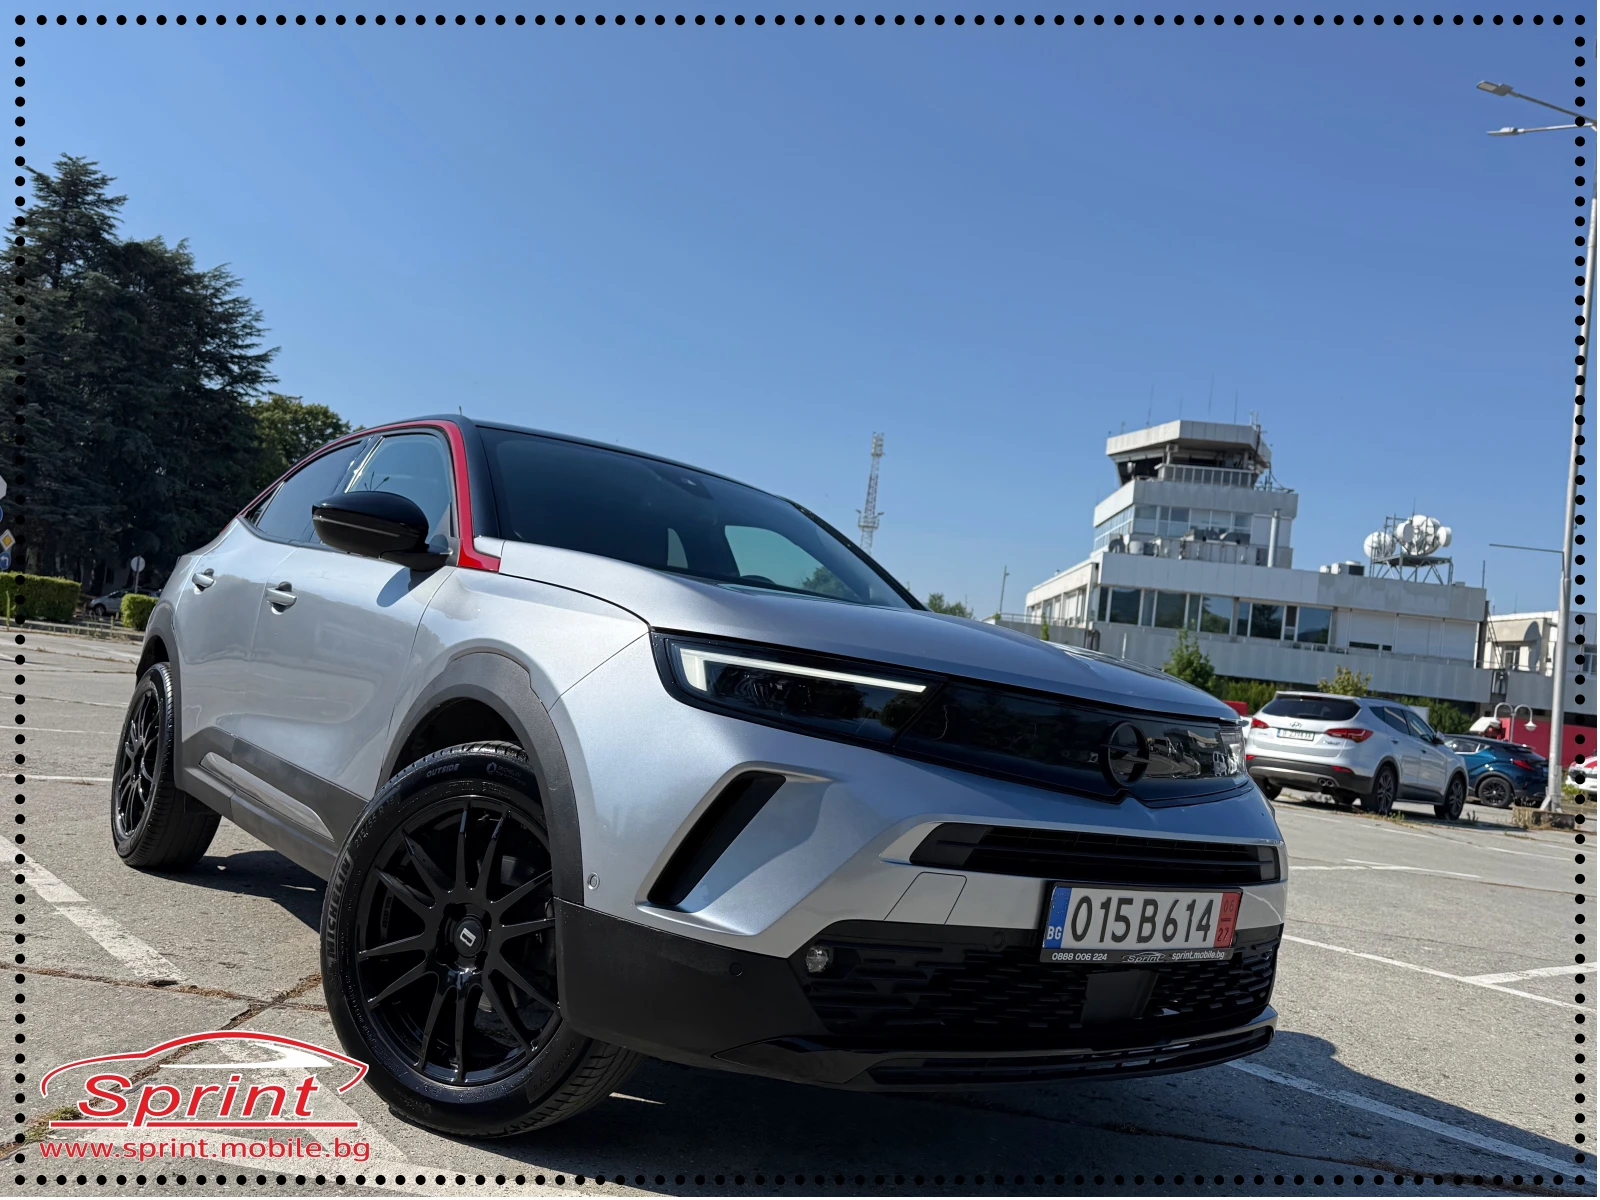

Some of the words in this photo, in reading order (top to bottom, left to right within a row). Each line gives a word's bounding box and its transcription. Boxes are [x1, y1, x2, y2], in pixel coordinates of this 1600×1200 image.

[426, 763, 460, 778] OUTSIDE
[326, 856, 352, 959] MICHELIN
[1223, 899, 1235, 913] 06
[1071, 895, 1214, 943] 015B614
[1047, 925, 1063, 940] BG
[1216, 927, 1229, 942] 27
[1051, 952, 1074, 961] 0888
[1075, 952, 1092, 961] 006
[1092, 952, 1108, 961] 224
[1171, 950, 1225, 961] sprint.mobile.bg
